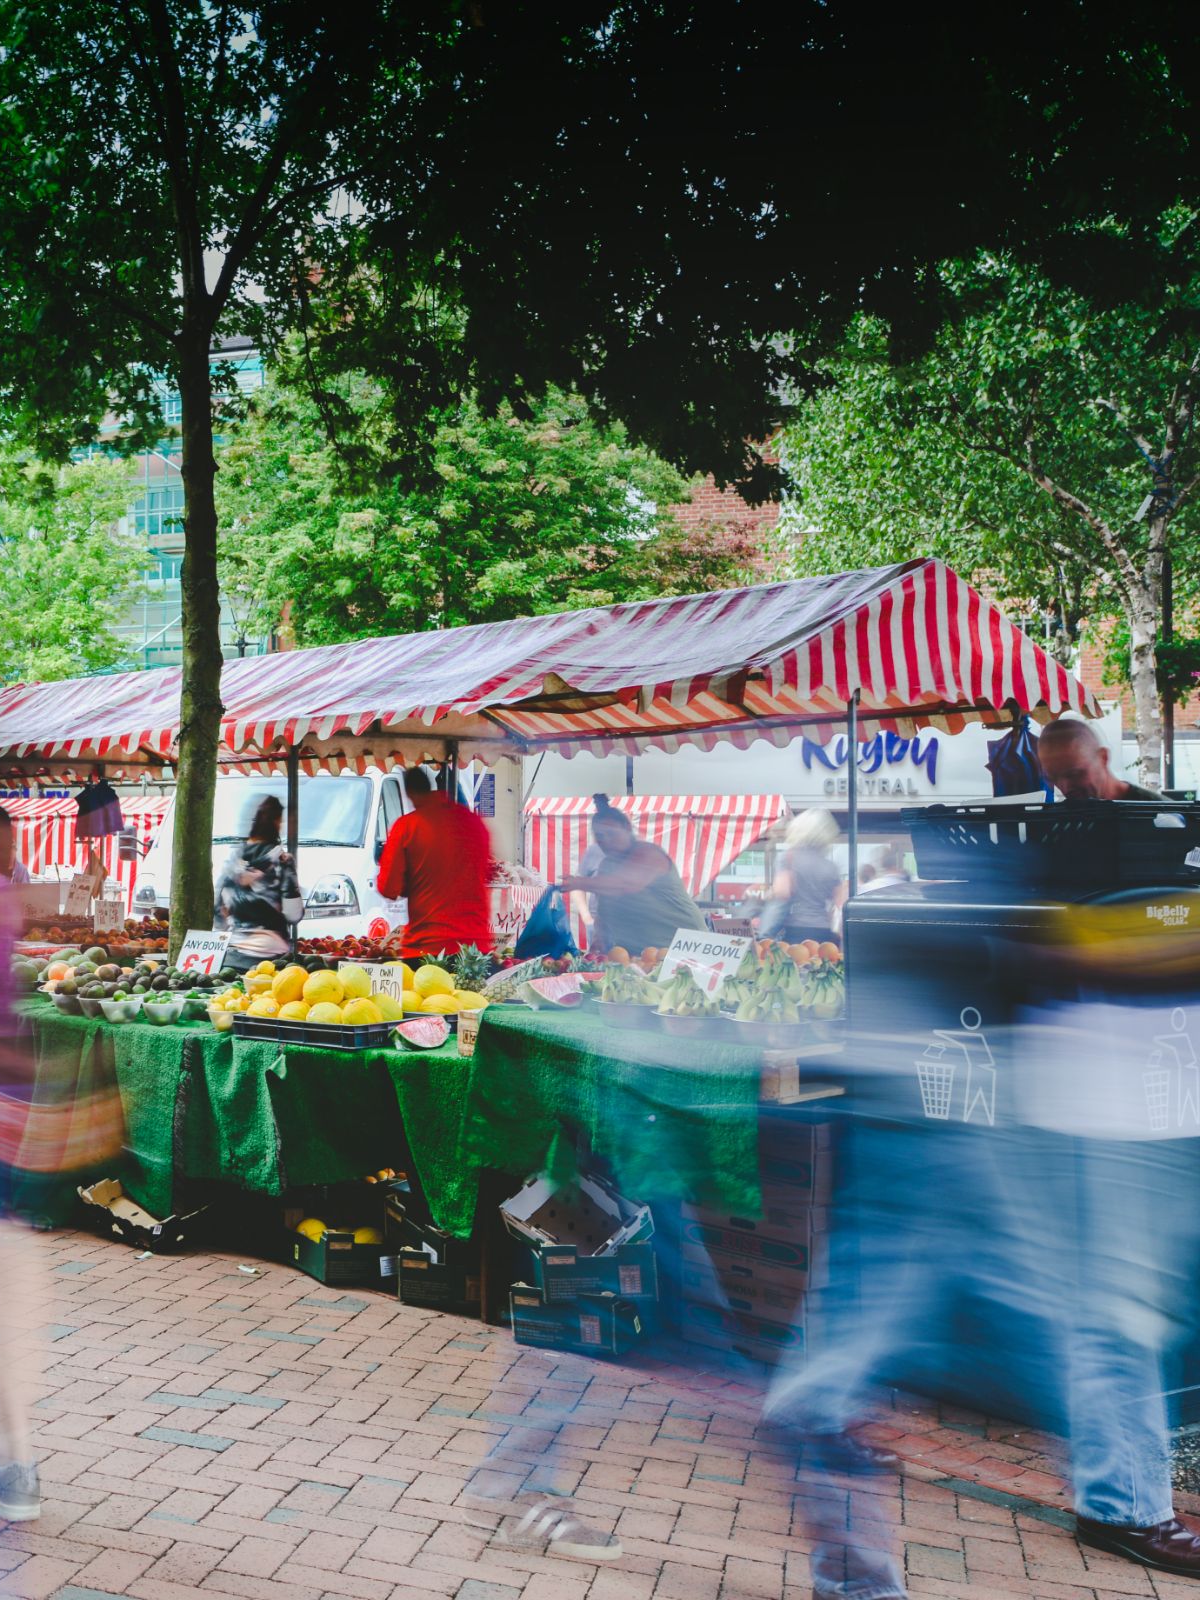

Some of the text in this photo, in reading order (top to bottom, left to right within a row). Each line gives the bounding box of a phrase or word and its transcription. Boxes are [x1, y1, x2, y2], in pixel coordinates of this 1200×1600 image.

[1146, 905, 1190, 920] BigBelly
[184, 940, 224, 950] ANY BOWL
[672, 940, 741, 959] ANY BOWL
[182, 954, 215, 975] £1
